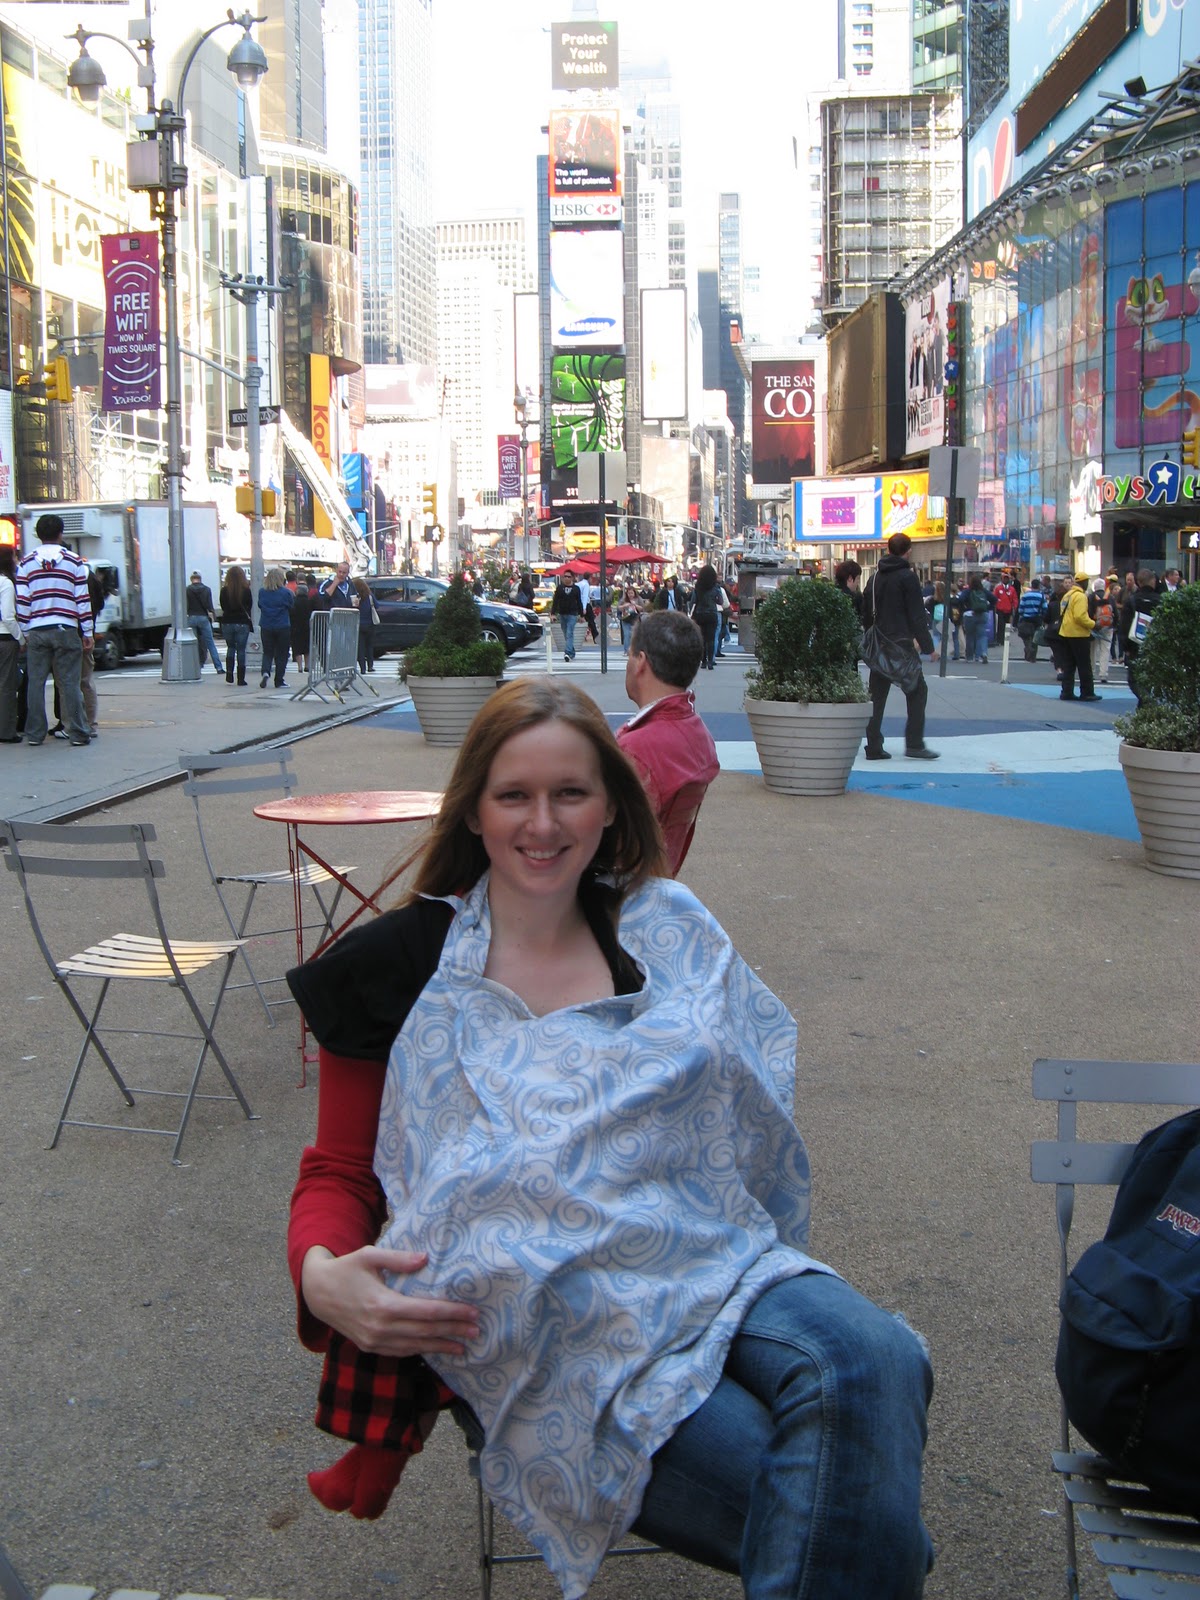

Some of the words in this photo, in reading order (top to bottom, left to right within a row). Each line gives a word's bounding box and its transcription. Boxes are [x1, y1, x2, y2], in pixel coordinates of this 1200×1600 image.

[561, 33, 608, 45] Protect
[569, 47, 600, 60] Your
[562, 61, 608, 74] Wealth
[554, 168, 569, 176] The
[569, 168, 588, 176] world
[90, 156, 126, 202] THE
[562, 177, 573, 185] full
[573, 177, 582, 185] of
[553, 203, 595, 216] HSBC
[113, 292, 151, 312] FREE
[115, 312, 148, 332] WIFI
[119, 333, 136, 342] NOW
[136, 333, 145, 341] IN
[107, 344, 128, 354] TIMES
[129, 343, 157, 354] SQUARE
[764, 375, 791, 388] THE
[111, 394, 152, 405] YAHOO!
[763, 388, 815, 418] CO
[236, 412, 248, 422] ON
[313, 404, 330, 459] Kod
[501, 455, 518, 463] FREE
[502, 463, 517, 471] WIFI
